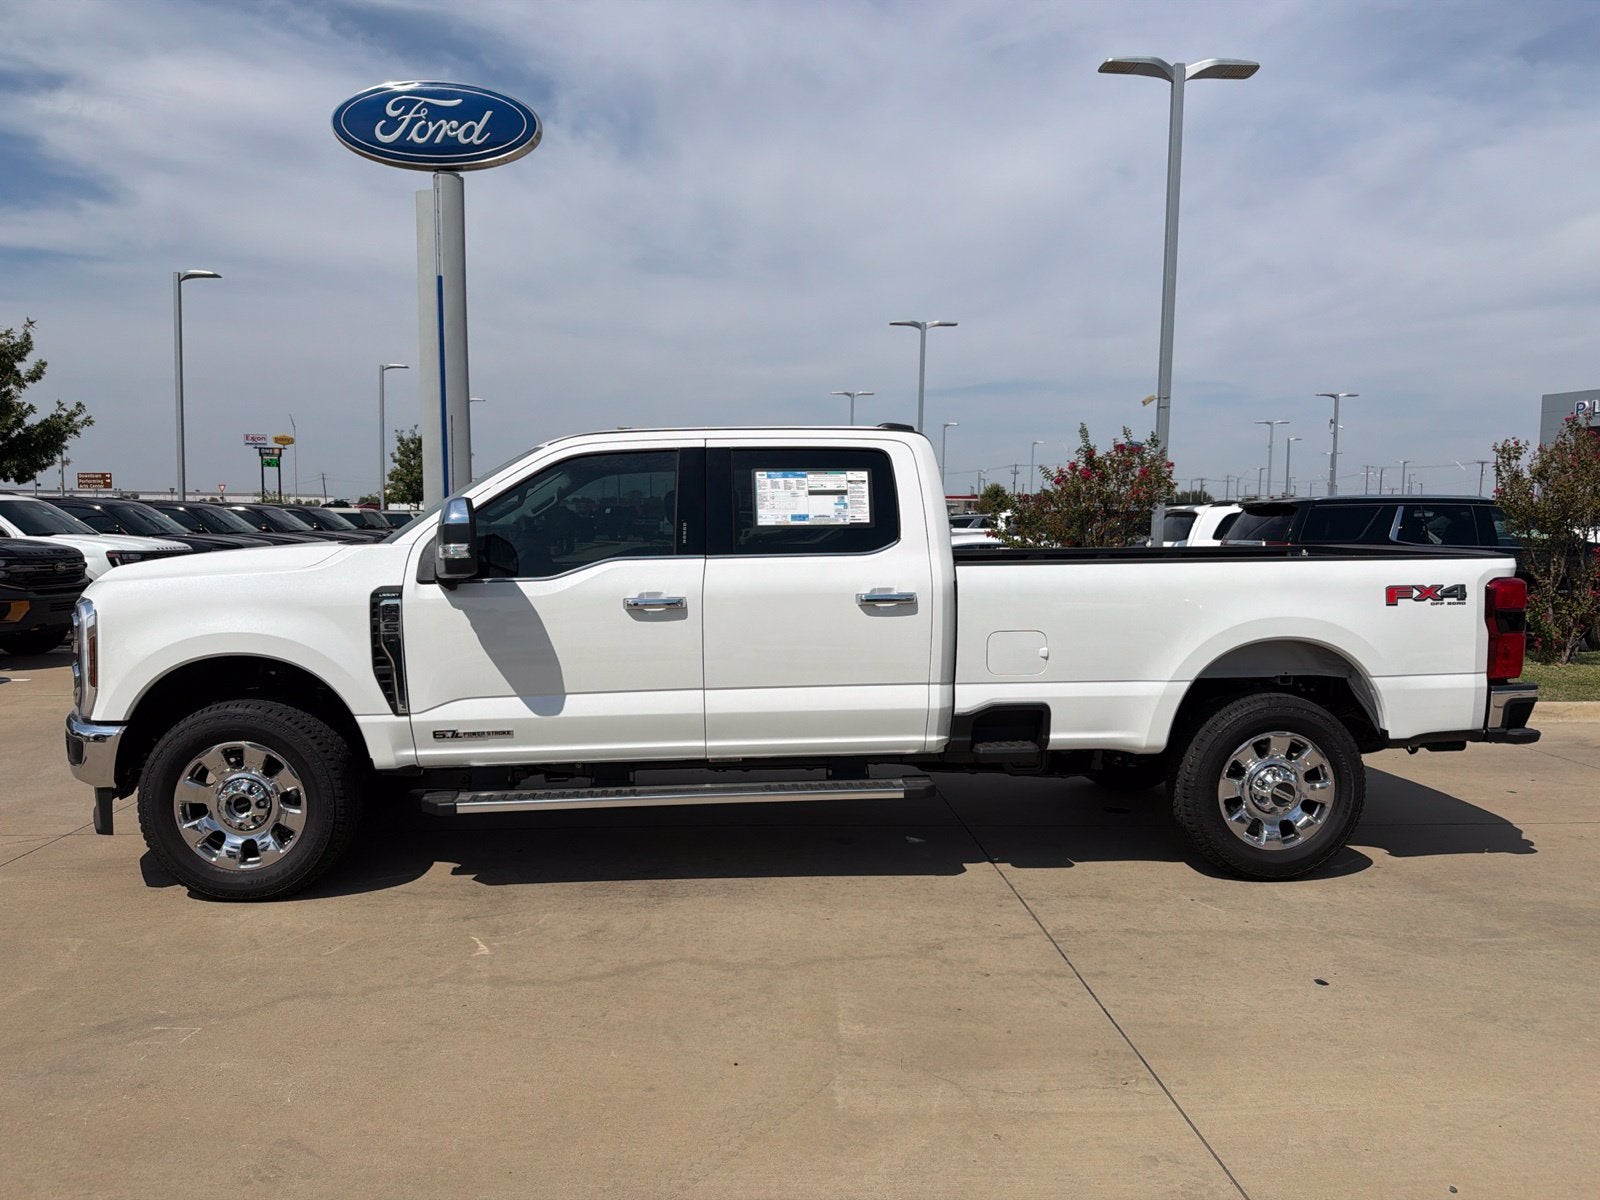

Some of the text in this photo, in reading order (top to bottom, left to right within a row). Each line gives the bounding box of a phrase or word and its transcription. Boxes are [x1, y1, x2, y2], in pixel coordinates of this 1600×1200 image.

[374, 95, 495, 145] Ford
[245, 434, 266, 443] Exxon
[1385, 584, 1467, 606] FX4
